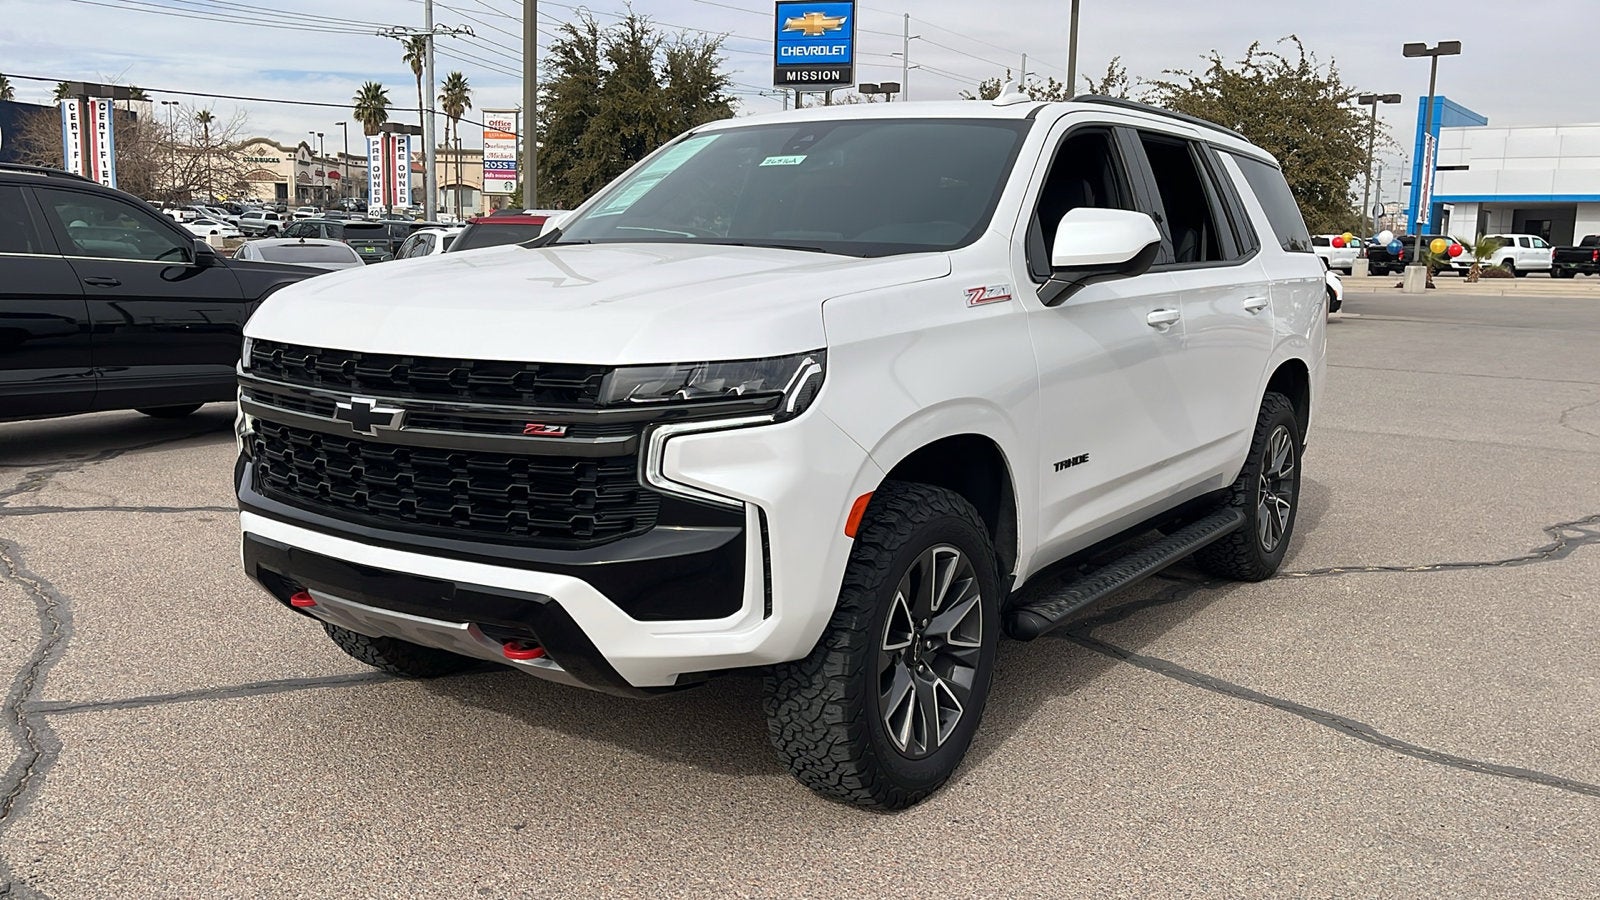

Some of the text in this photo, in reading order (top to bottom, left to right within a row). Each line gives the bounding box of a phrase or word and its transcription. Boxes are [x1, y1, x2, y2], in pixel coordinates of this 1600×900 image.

[781, 45, 847, 56] CHEVROLET
[786, 71, 840, 80] MISSION
[68, 102, 79, 175] CERTIFIE
[98, 102, 110, 187] CERTIFIED
[371, 140, 380, 162] PRE
[397, 138, 408, 204] PRE OWNED
[484, 161, 509, 169] ROSS
[372, 166, 382, 204] OWNED
[369, 209, 380, 217] 40
[522, 423, 567, 437] Z71
[1053, 452, 1090, 473] TAHOE
